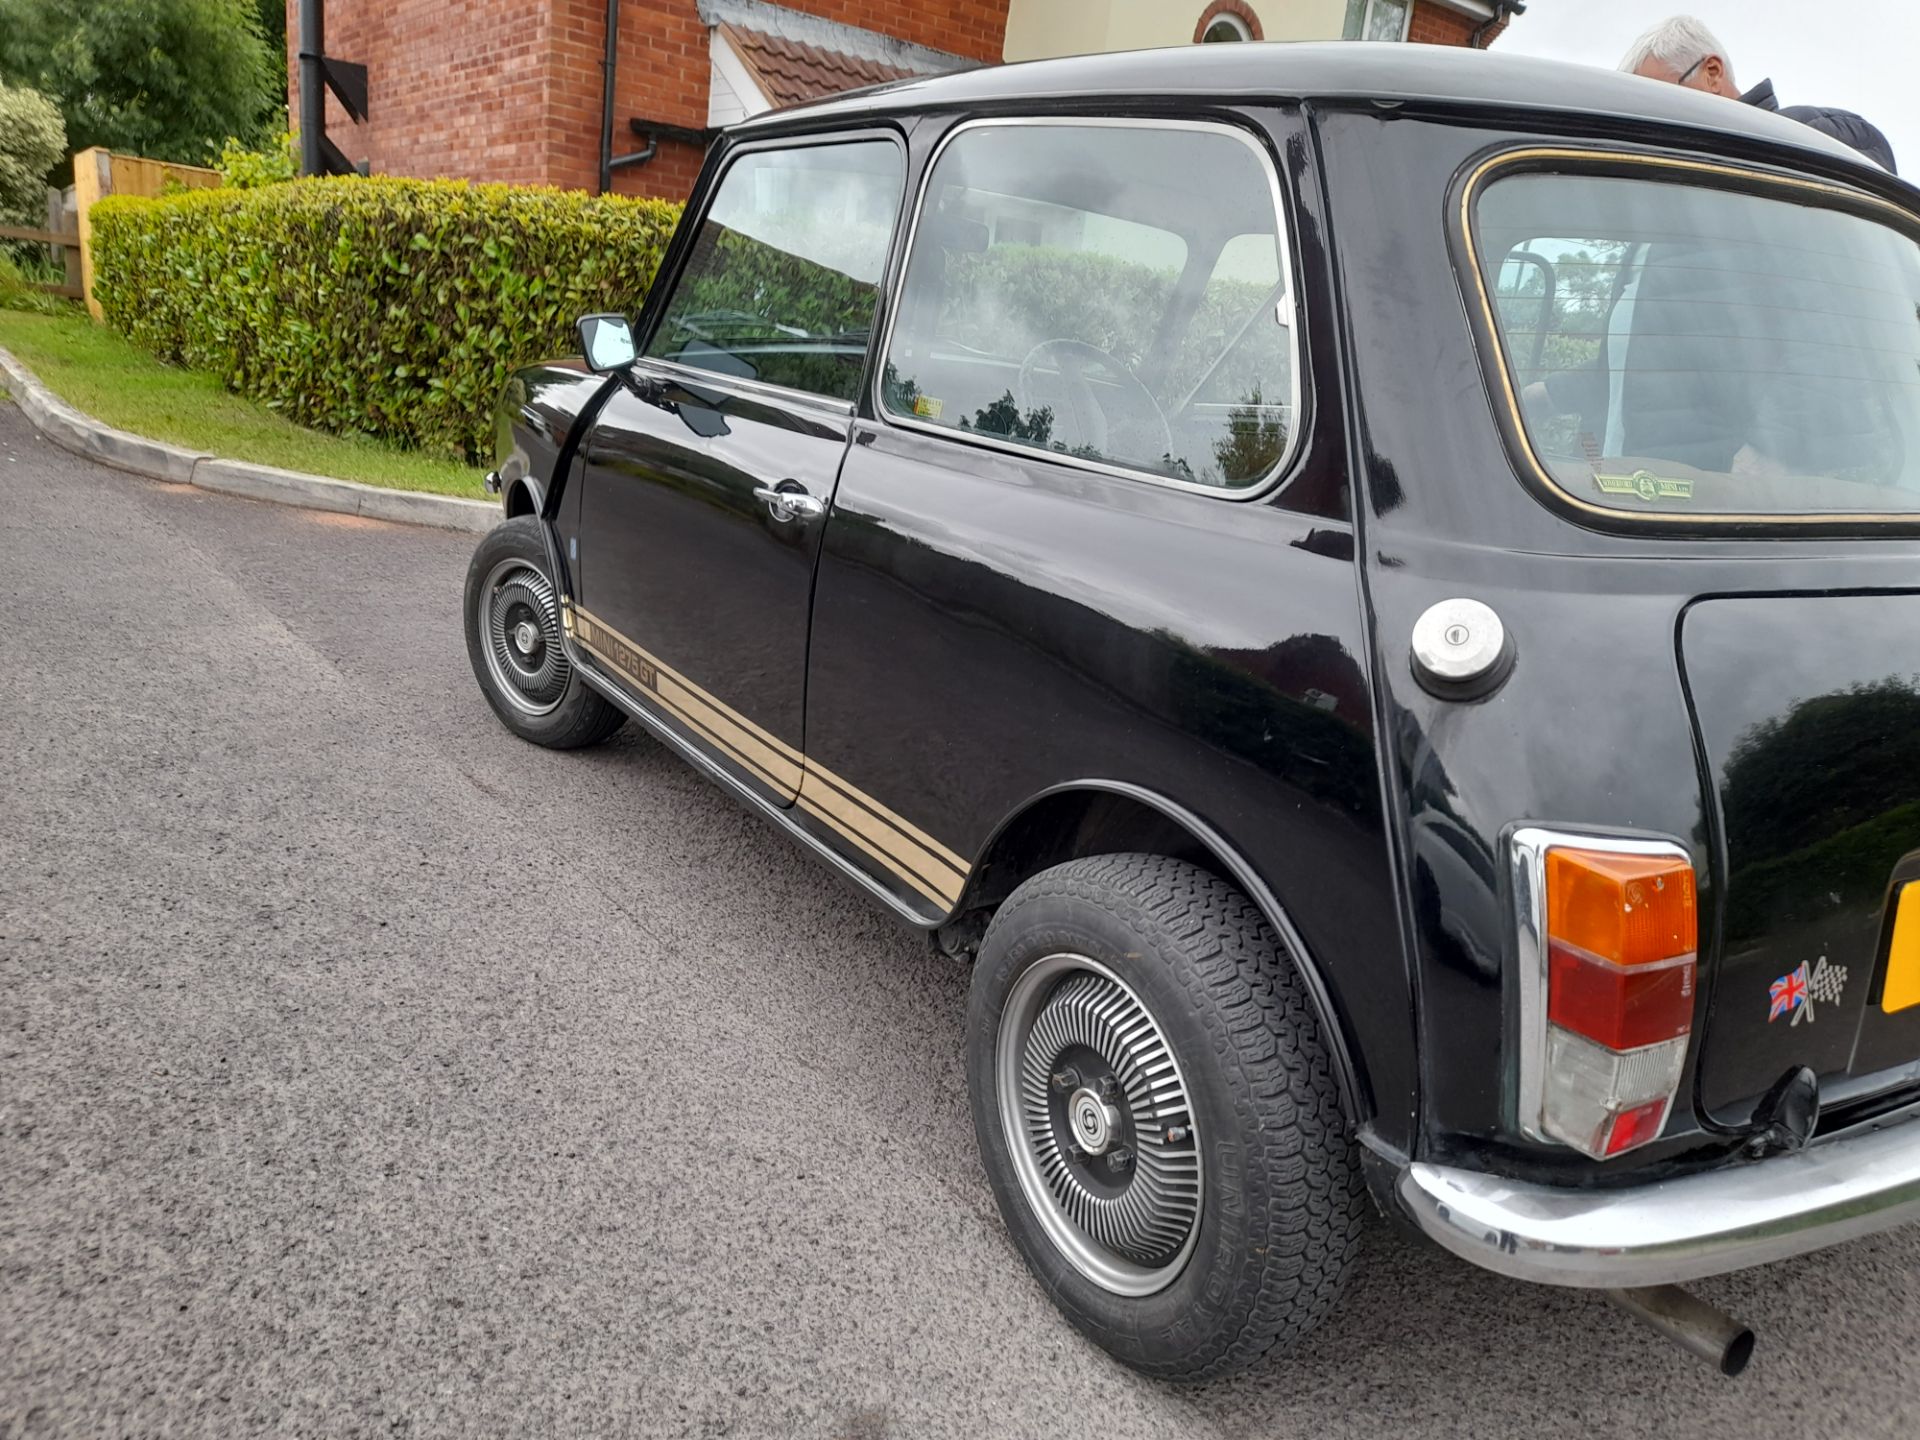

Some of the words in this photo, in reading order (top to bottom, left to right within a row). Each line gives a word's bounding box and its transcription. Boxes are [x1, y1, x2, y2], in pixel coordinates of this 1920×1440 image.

[591, 624, 613, 656] MINI
[614, 643, 639, 675] 1275
[639, 660, 656, 687] GT
